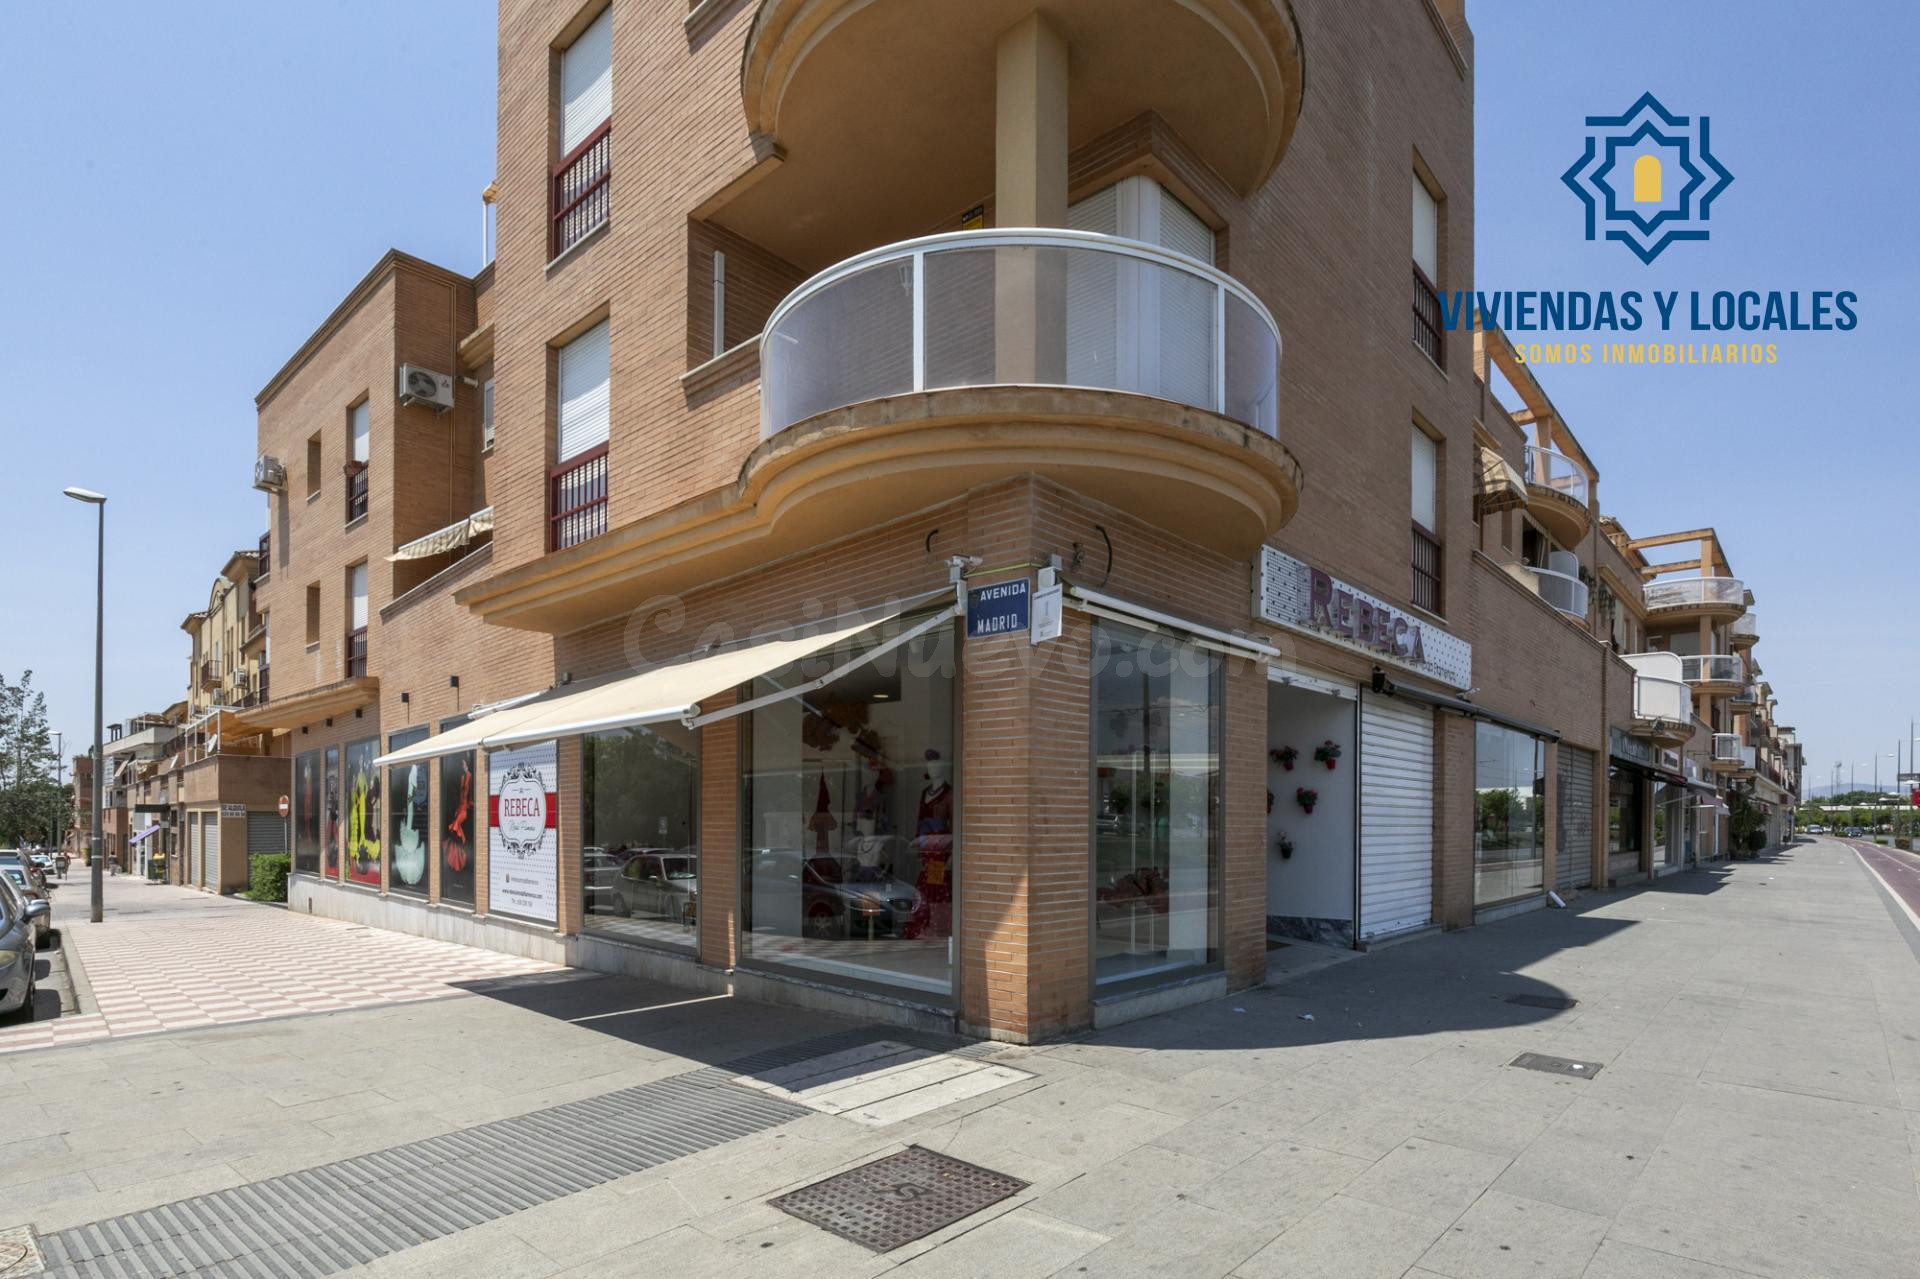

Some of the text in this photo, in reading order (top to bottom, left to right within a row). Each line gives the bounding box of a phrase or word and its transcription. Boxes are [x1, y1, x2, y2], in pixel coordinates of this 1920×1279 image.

[981, 584, 1026, 601] AVENIDA
[977, 613, 1018, 634] MADRID
[1309, 566, 1425, 663] REBECA
[504, 797, 540, 817] REBECA
